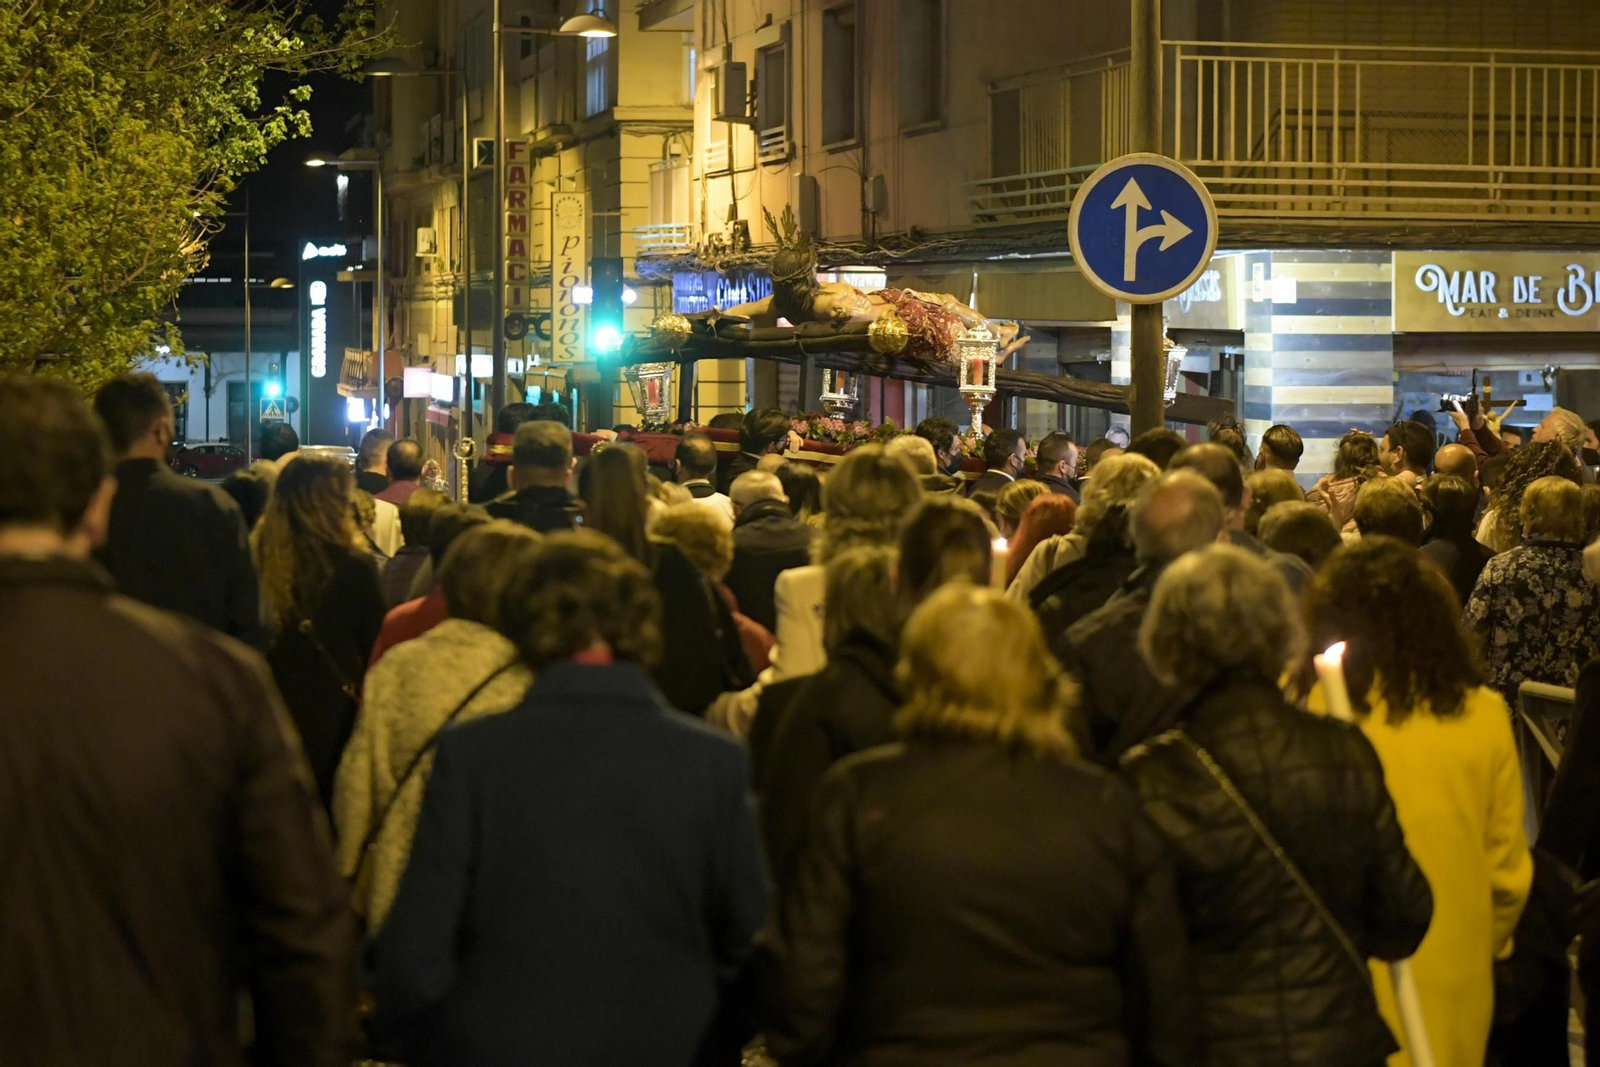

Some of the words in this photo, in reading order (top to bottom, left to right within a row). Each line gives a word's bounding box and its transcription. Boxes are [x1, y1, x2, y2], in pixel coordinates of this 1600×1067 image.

[1415, 263, 1497, 317] MAR
[1513, 275, 1542, 304] DE
[1557, 263, 1600, 316] B
[1470, 309, 1493, 318] EAT
[1497, 307, 1509, 319] &
[1515, 309, 1557, 318] DRINK
